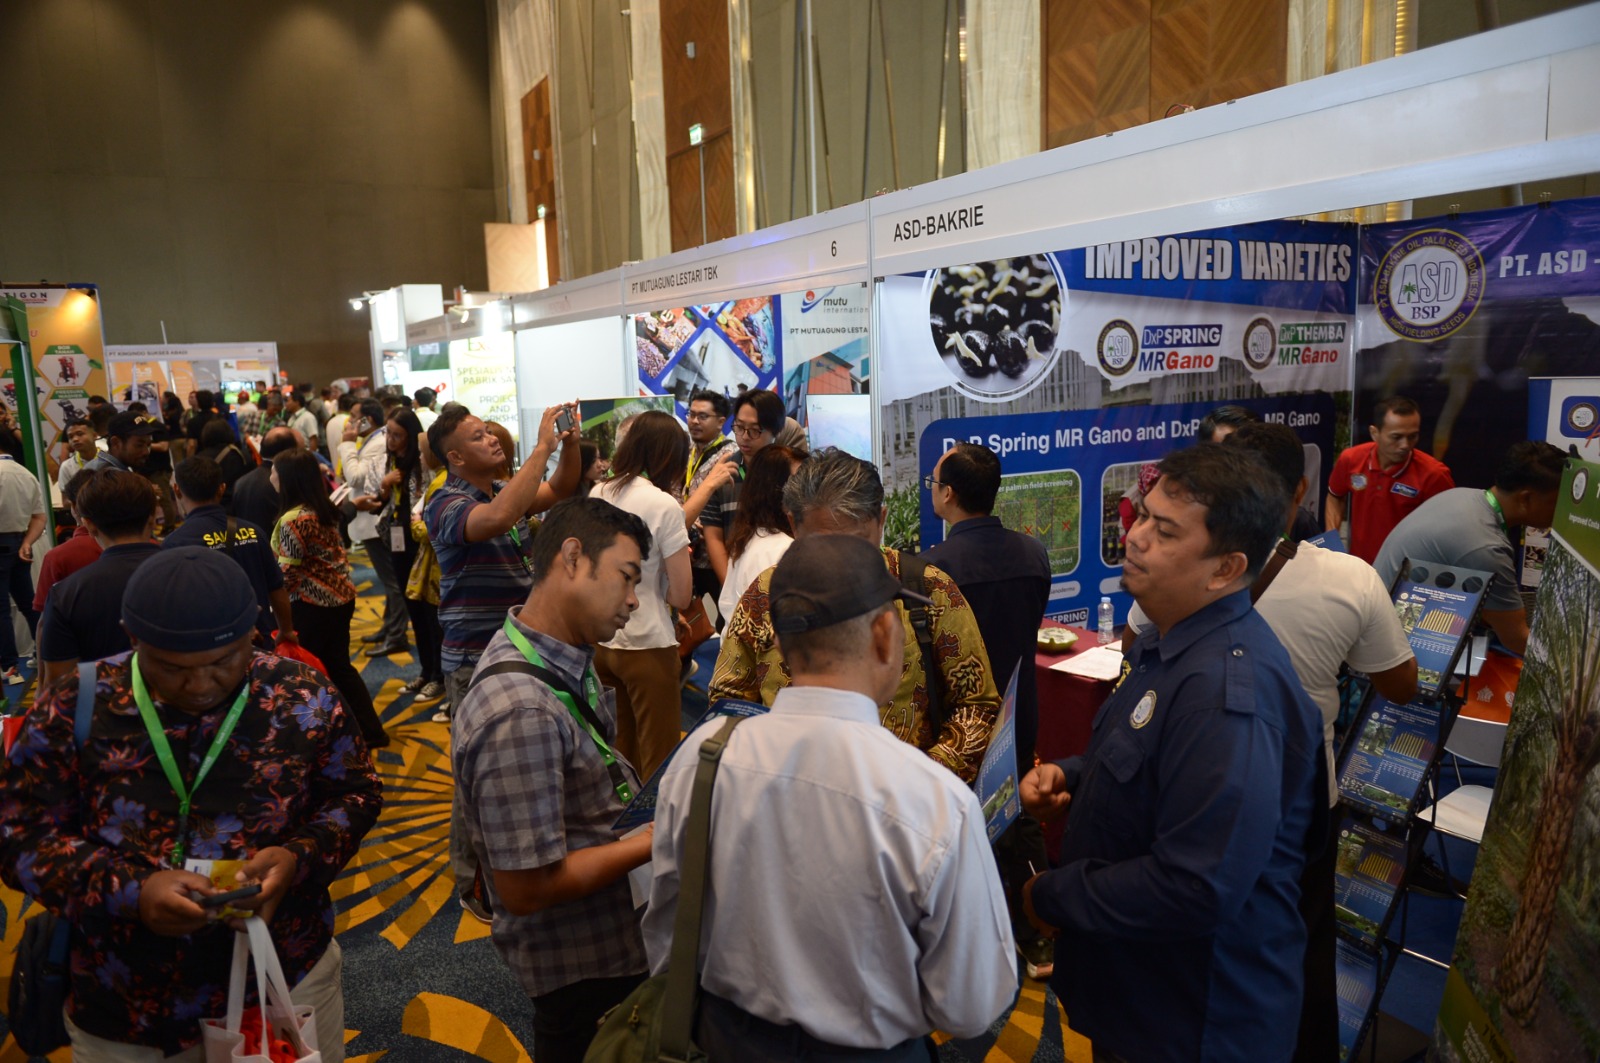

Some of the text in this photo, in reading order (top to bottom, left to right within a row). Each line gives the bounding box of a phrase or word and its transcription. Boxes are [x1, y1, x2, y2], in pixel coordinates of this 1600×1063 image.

[893, 204, 984, 243] ASD-BAKRIE
[831, 240, 838, 257] 6
[1085, 237, 1352, 283] IMPROVED VARIETIES
[1406, 240, 1422, 251] OIL
[1422, 236, 1446, 245] PALM
[1446, 238, 1468, 256] SEED
[1465, 254, 1479, 302] INDONESIA
[1499, 254, 1532, 278] PT.
[1536, 249, 1587, 276] ASD
[631, 265, 719, 295] PT MUTUAGUNG LESTARI TBK
[1398, 260, 1458, 305] ASD
[823, 297, 849, 306] mutu
[1411, 305, 1441, 320] BSP
[800, 326, 847, 335] MUTUAGUNG
[1441, 312, 1466, 333] SEEDS
[988, 431, 1050, 458] Spring
[1056, 428, 1084, 449] MR
[1088, 426, 1133, 446] Gano
[1136, 421, 1166, 442] and
[1171, 419, 1201, 440] DxP
[1288, 410, 1320, 427] Gano
